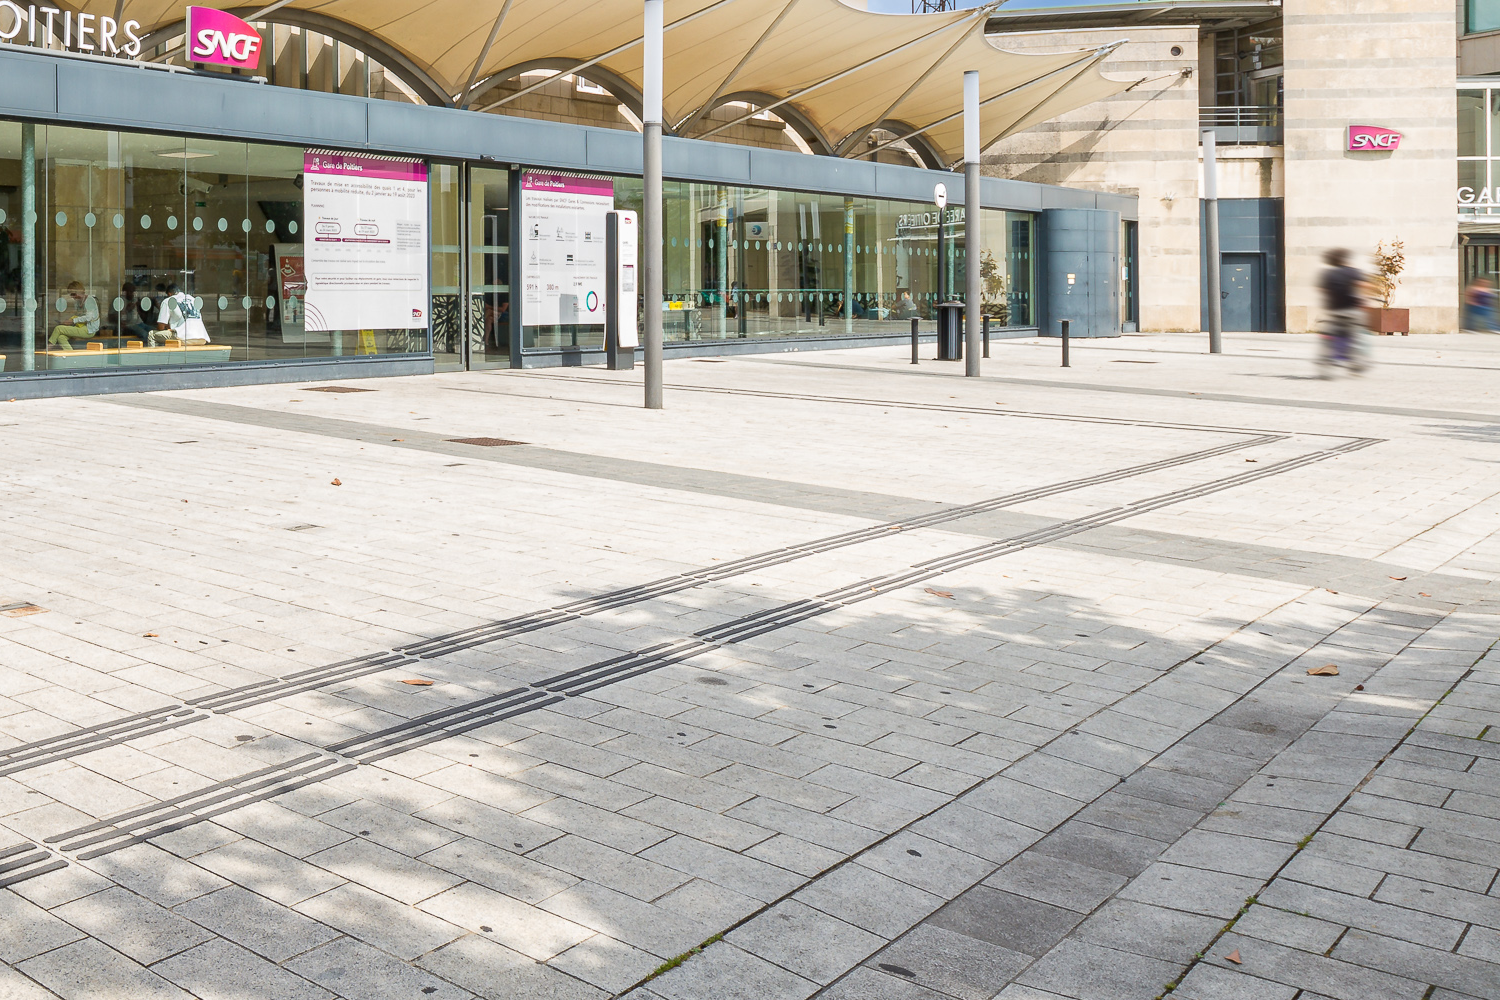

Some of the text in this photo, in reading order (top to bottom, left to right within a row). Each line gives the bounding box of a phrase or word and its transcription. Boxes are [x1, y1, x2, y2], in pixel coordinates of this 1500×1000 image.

[193, 29, 261, 61] SNCF
[1352, 134, 1400, 147] SNCF
[322, 161, 335, 169] Gare
[343, 162, 362, 171] Poitiers
[534, 178, 543, 186] Gare
